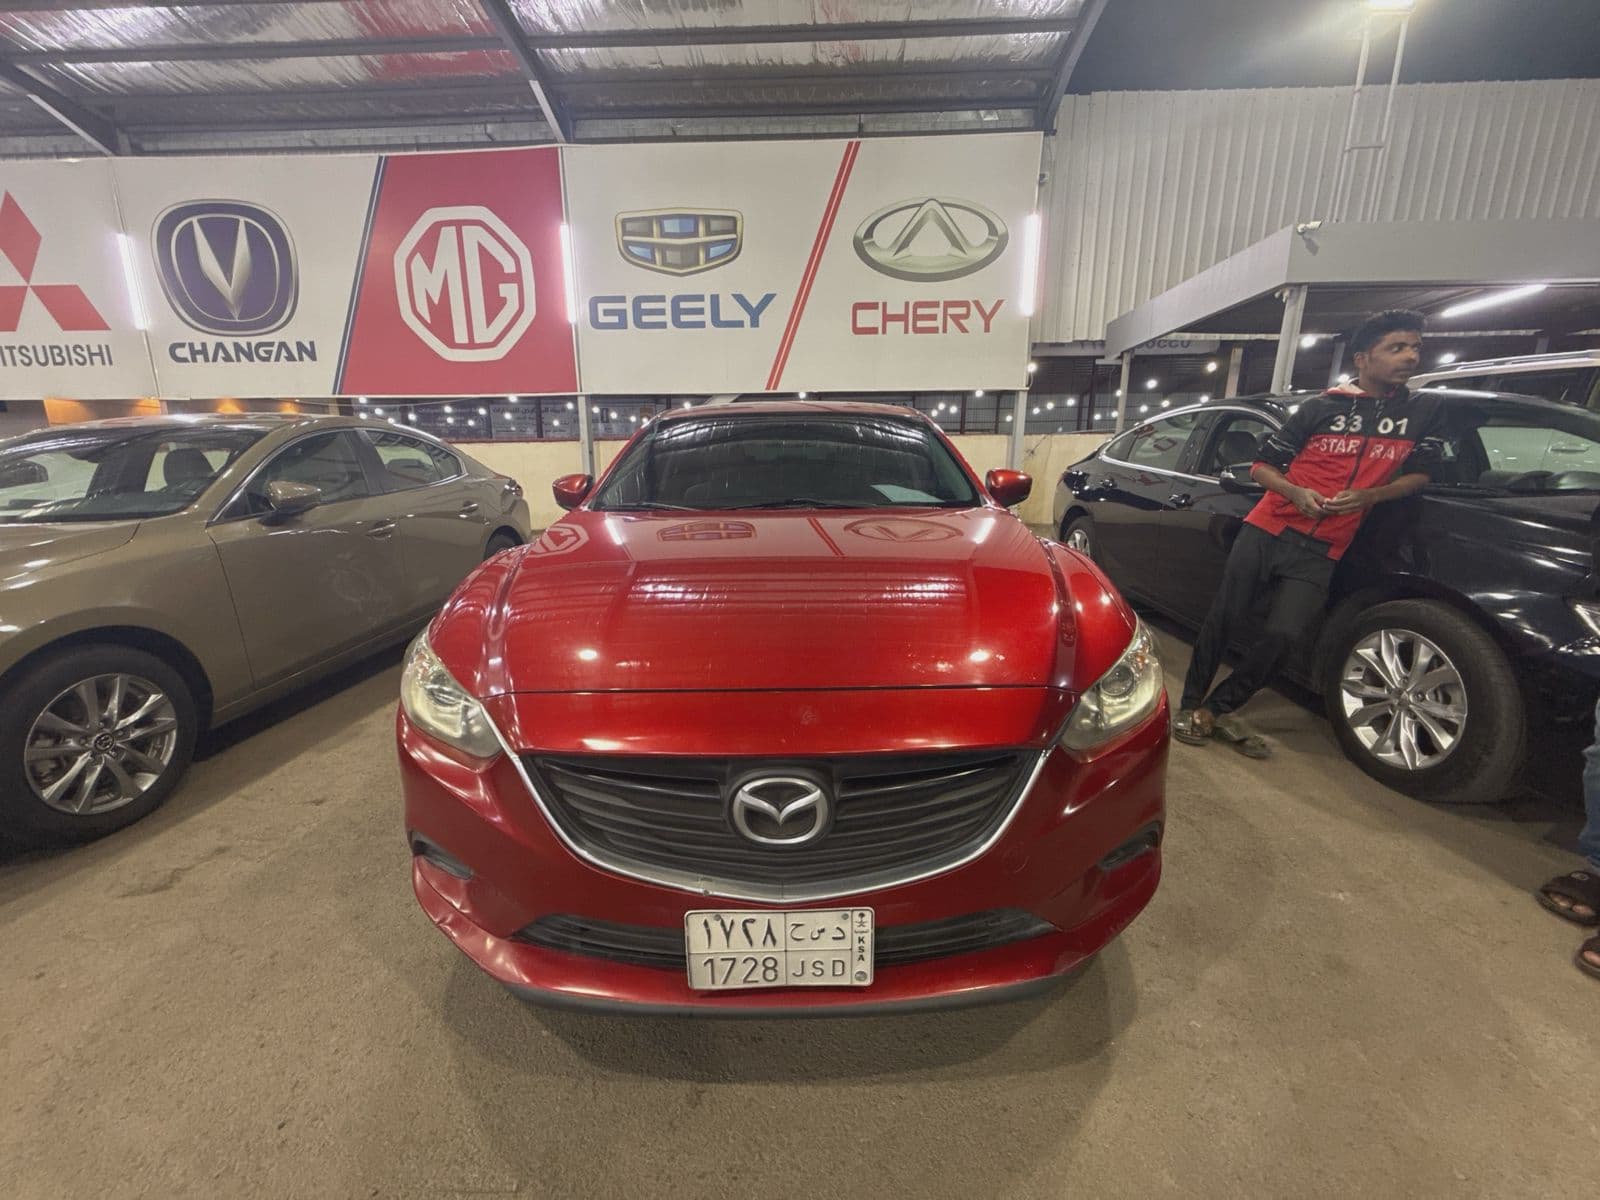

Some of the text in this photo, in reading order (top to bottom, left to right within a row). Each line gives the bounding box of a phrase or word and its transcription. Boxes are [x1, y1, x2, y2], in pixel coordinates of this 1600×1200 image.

[410, 225, 520, 344] MG
[588, 293, 777, 330] GEELY
[851, 299, 1005, 335] CHERY
[168, 341, 317, 363] CHANGAN
[1329, 414, 1409, 435] 33 01
[857, 935, 866, 962] KSA
[702, 956, 779, 985] 1728
